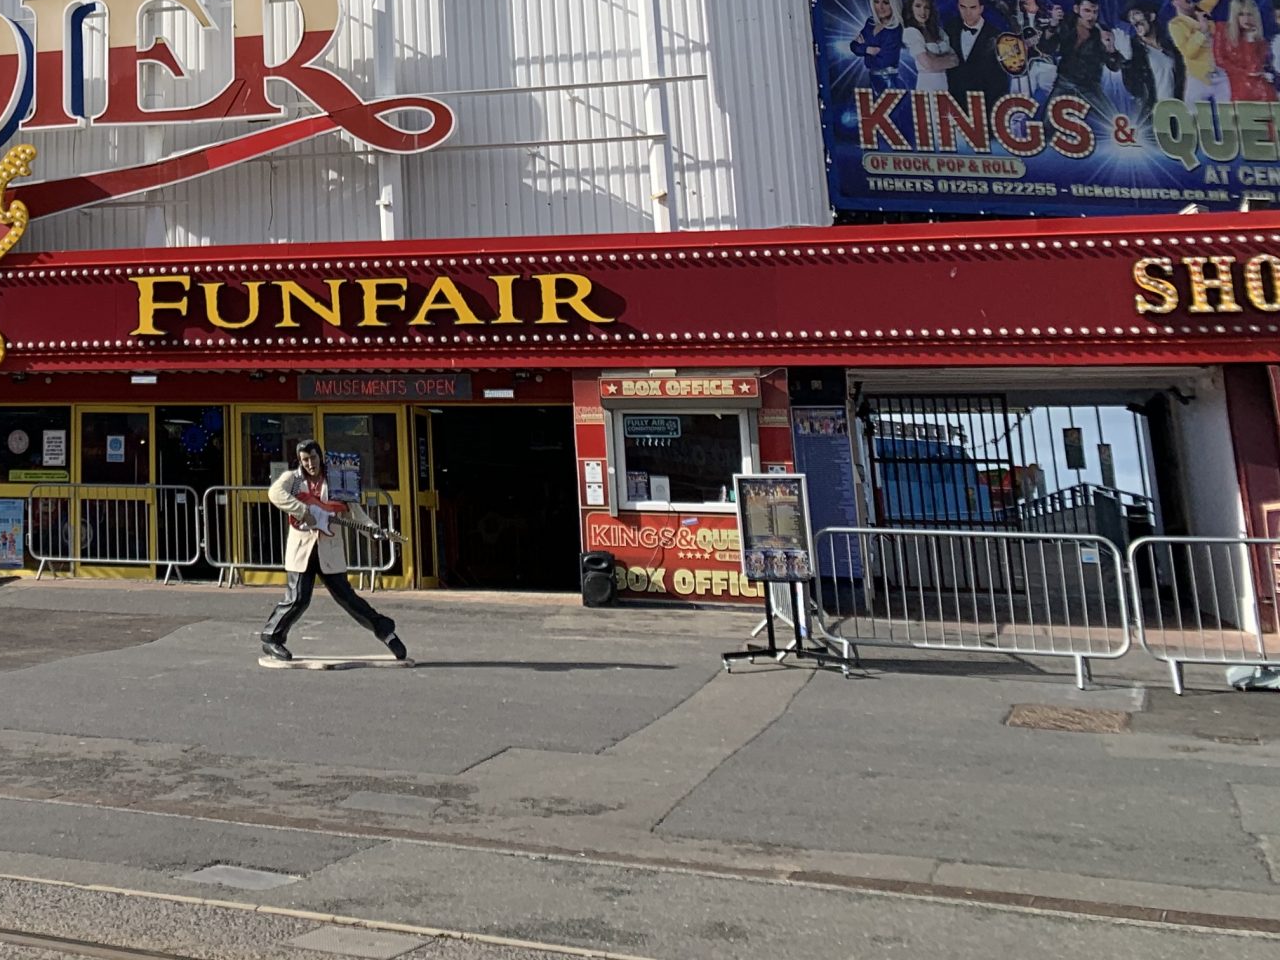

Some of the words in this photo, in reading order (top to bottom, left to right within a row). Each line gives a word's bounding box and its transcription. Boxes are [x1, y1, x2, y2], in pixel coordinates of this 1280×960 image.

[853, 87, 1096, 159] KINGS
[1113, 115, 1138, 145] &
[1152, 96, 1280, 171] QUE
[871, 157, 888, 171] OF
[937, 159, 964, 172] POP
[967, 160, 979, 173] &
[982, 160, 1019, 175] ROLL
[1204, 165, 1231, 185] AT
[867, 176, 935, 193] TICKETS
[937, 180, 989, 195] 01253
[992, 181, 1058, 197] 622255
[1071, 184, 1230, 202] ticketsource.co.uk
[1131, 253, 1280, 315] SHO
[128, 273, 616, 337] FUNFAIR
[314, 378, 407, 395] AMUSEMENTS
[415, 378, 455, 395] OPEN
[622, 379, 662, 396] BOX
[665, 379, 735, 396] OFFICE
